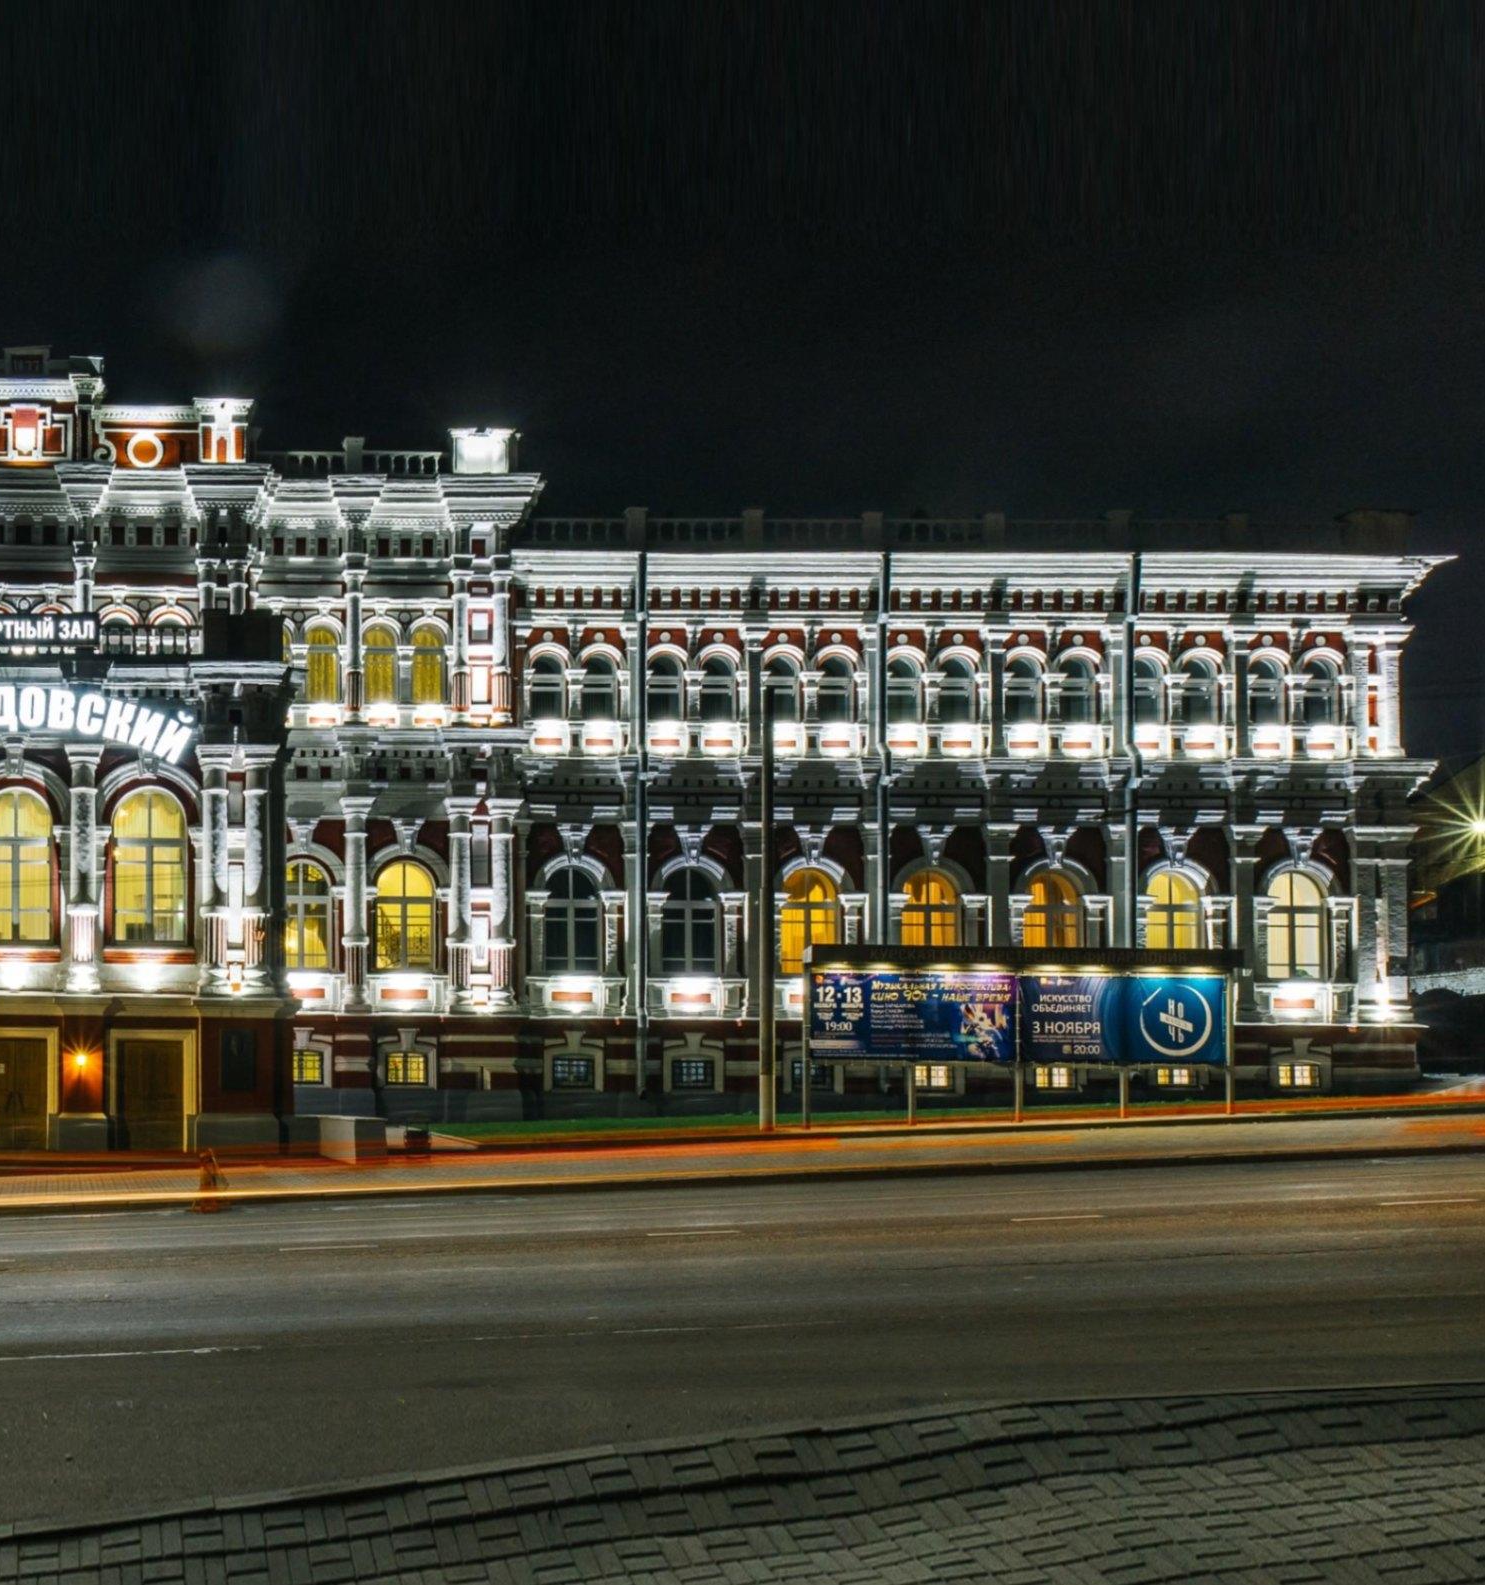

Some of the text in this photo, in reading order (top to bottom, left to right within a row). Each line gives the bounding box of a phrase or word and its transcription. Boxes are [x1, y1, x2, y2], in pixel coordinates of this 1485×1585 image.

[58, 620, 95, 639] ЗАЛ
[817, 986, 862, 1004] 12 13
[941, 993, 972, 1002] НАШЕ
[975, 993, 1011, 1003] ВРЕМЯ
[1039, 994, 1092, 1003] ИСКУССТВО
[1032, 1003, 1092, 1013] ОБЪЕДИНЯЕТ
[825, 1022, 853, 1031] 19:00
[1033, 1021, 1101, 1034] 3 НОЯБРЯ
[1073, 1045, 1100, 1054] 20:00
